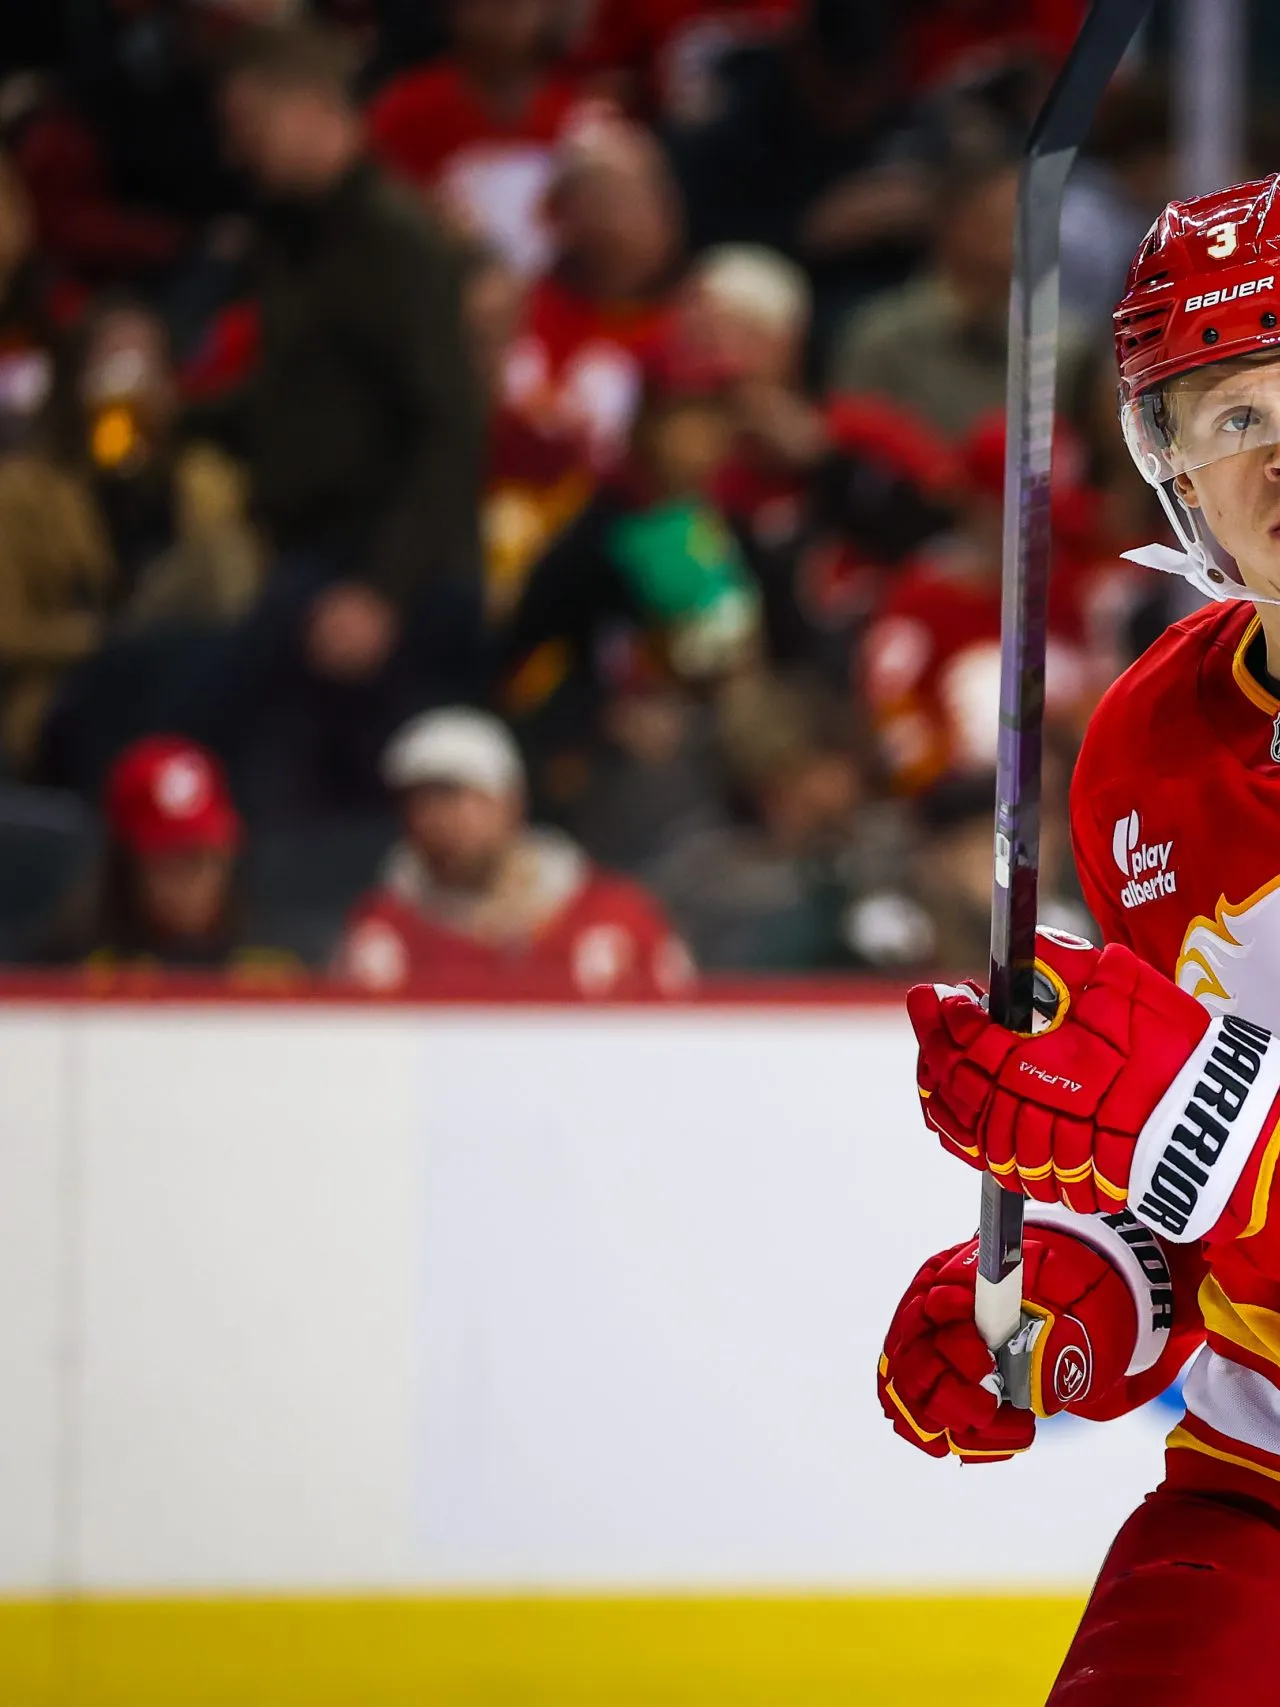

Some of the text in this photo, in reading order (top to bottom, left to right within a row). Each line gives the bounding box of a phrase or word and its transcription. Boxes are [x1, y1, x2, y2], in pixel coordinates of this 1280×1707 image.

[1207, 222, 1239, 260] 3
[1185, 276, 1274, 312] BAUER
[1132, 841, 1173, 879] play
[1121, 870, 1176, 908] alberta
[1020, 1061, 1082, 1092] ALPHA
[1137, 1015, 1272, 1236] WARRIOR
